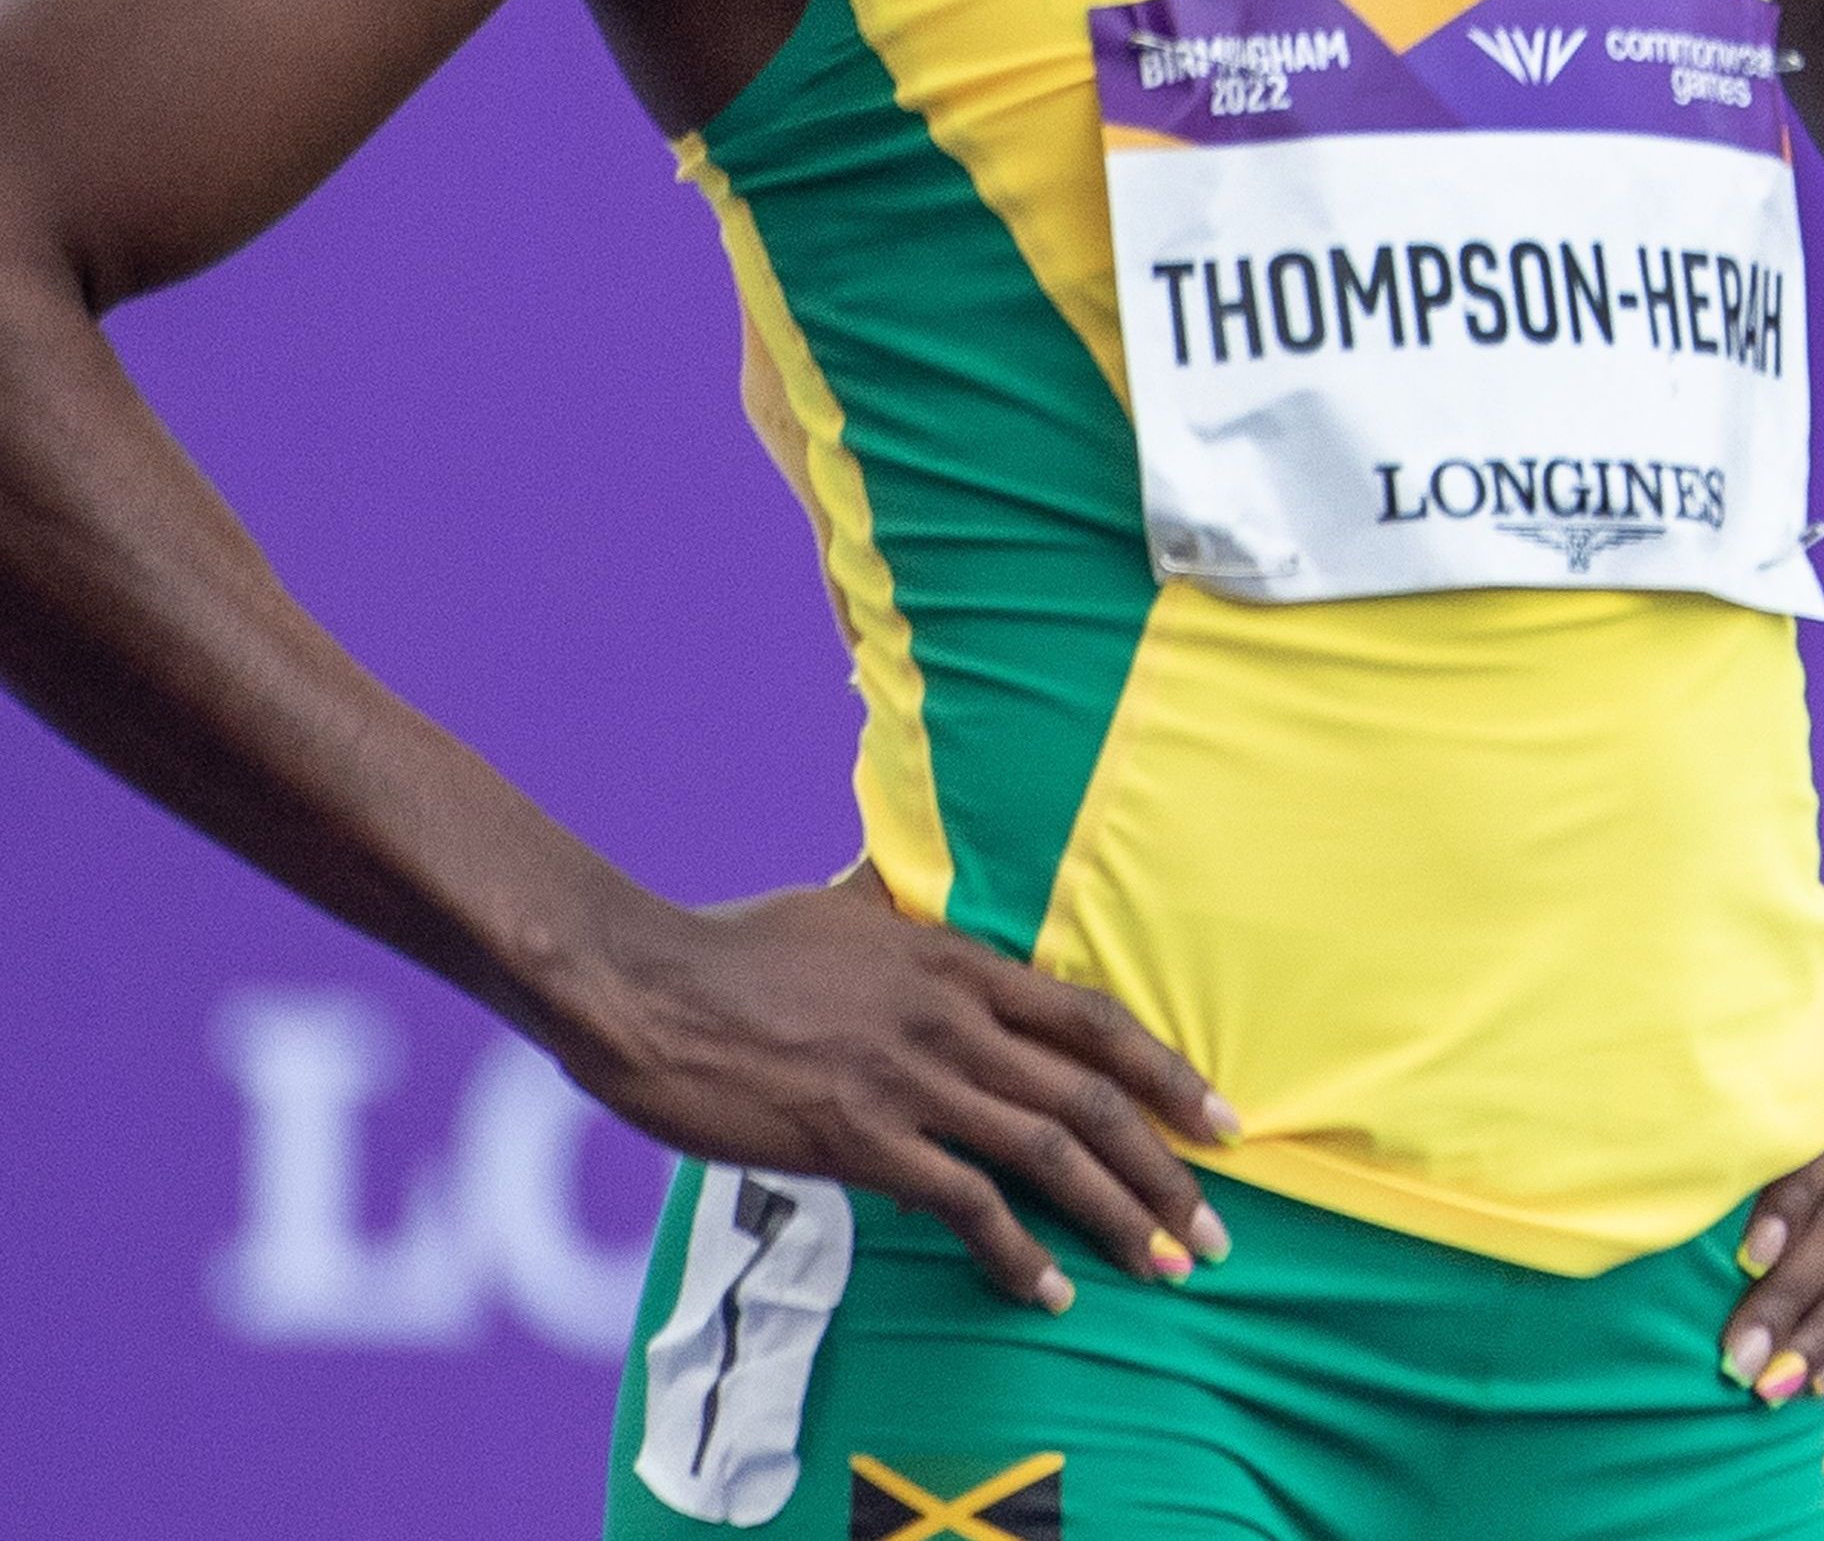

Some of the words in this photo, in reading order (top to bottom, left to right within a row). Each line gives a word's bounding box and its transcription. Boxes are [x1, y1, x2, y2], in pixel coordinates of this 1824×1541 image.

[1210, 73, 1292, 116] 2022
[1152, 242, 1784, 379] THOMPSON-HERAH
[1375, 457, 1726, 532] LONGINES
